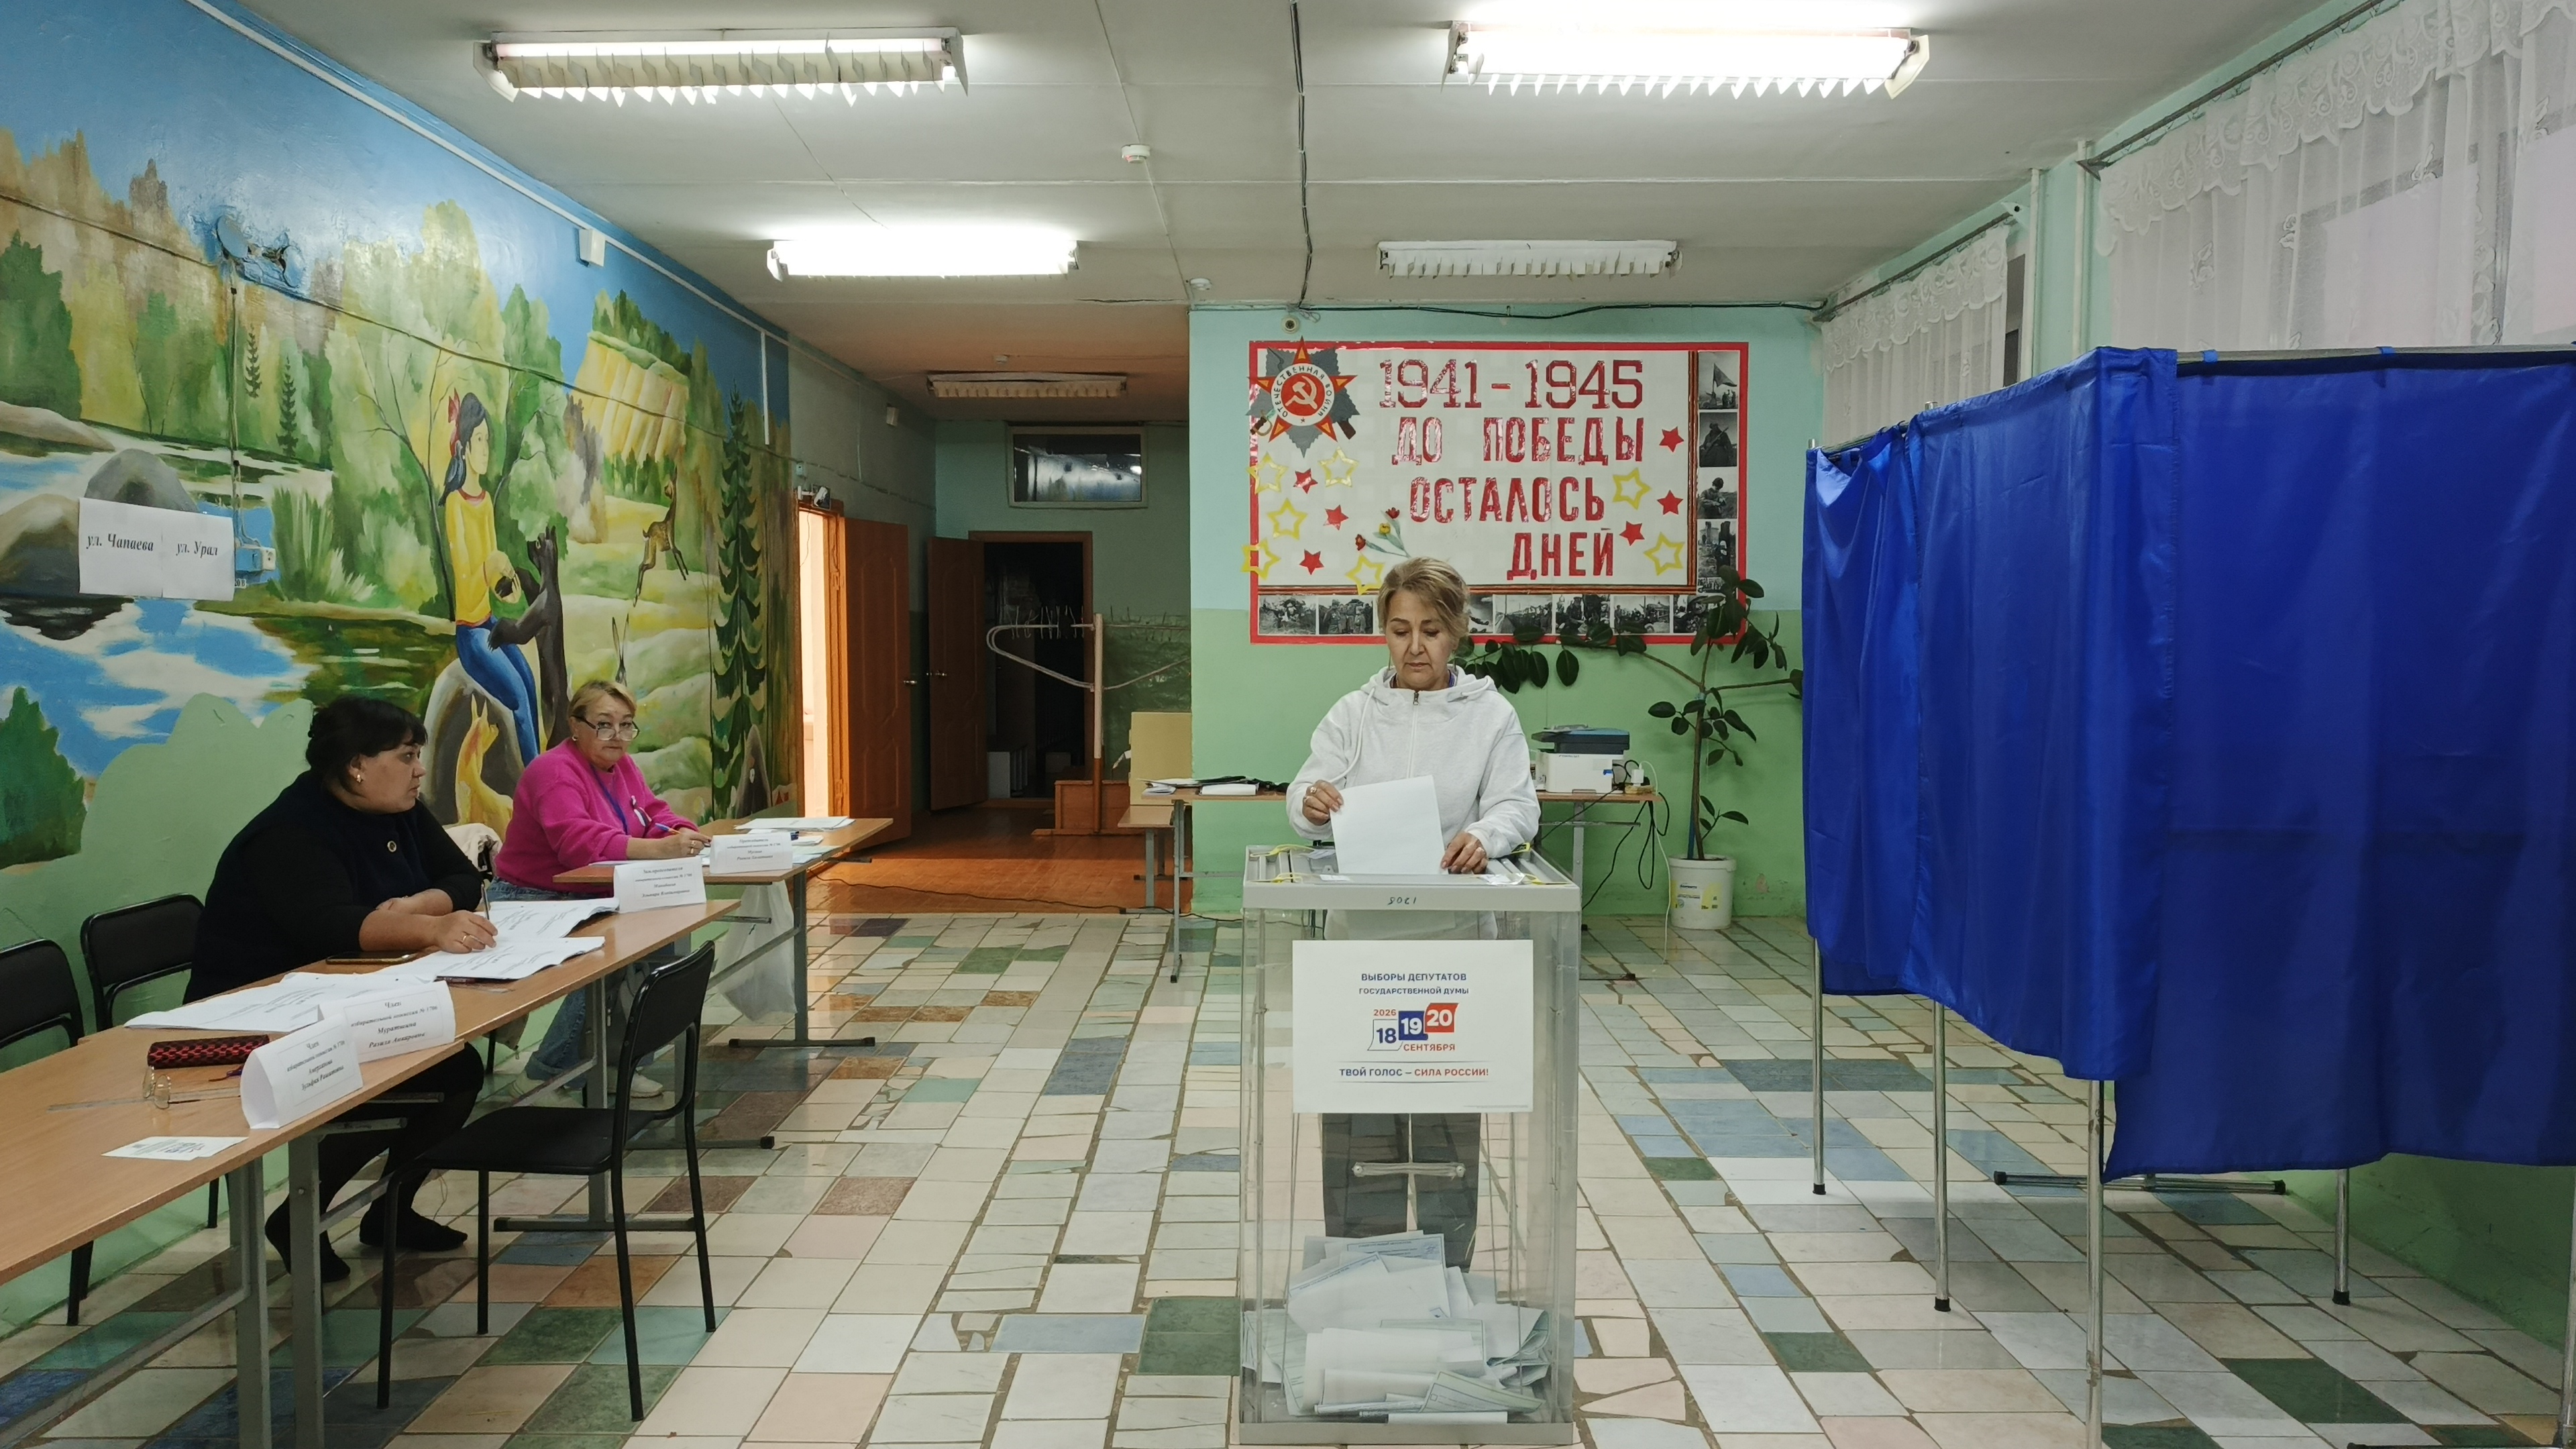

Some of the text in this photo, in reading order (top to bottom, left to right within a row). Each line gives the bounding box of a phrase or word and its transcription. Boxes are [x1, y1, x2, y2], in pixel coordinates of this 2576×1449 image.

[1274, 366, 1325, 417] ОТЕЧЕСТВЕННАЯ
[1379, 359, 1481, 409] 1941
[1525, 359, 1643, 409] 1945
[1391, 416, 1644, 466] ДО ПОБЕДЫ
[1409, 476, 1604, 523] ОСТАЛОСЬ
[86, 533, 154, 551] ул. Чапаева
[176, 541, 219, 558] ул. Урал
[1507, 528, 1614, 580] ДНЕЙ
[1359, 987, 1442, 995] ГОСУДАРСТВЕННОЙ
[1361, 973, 1467, 982] ВЫБОРЫ ДЕПУТАТОВ
[1376, 1010, 1452, 1044] 18 19 20
[1340, 1067, 1366, 1077] ТВОЙ
[1370, 1069, 1403, 1077] ГОЛОС
[1414, 1069, 1442, 1077] СИЛА
[1445, 1069, 1489, 1077] РОССИИ!
